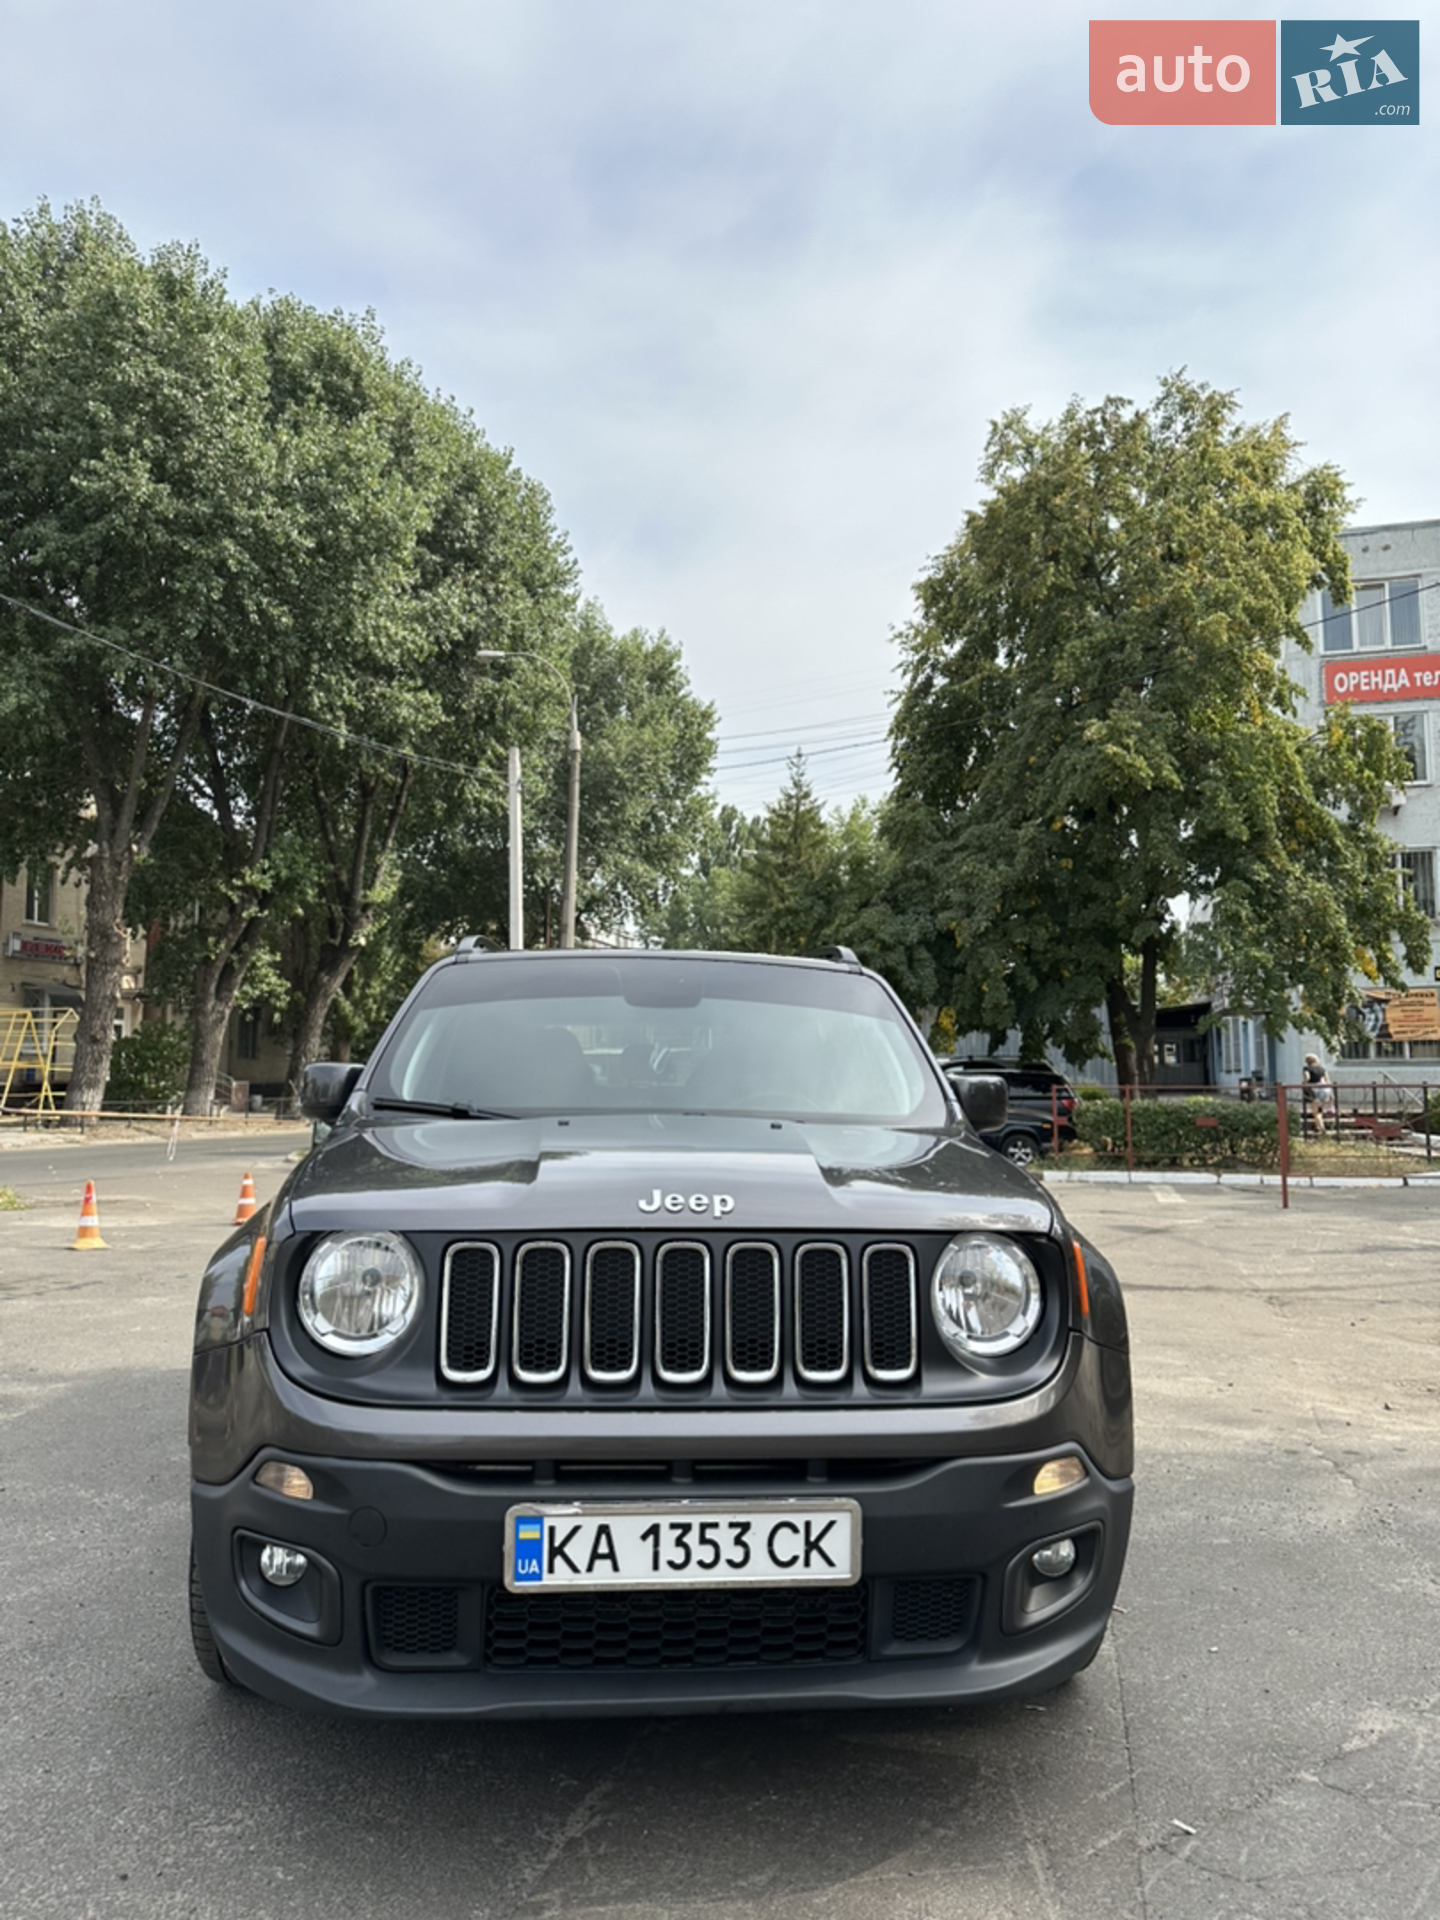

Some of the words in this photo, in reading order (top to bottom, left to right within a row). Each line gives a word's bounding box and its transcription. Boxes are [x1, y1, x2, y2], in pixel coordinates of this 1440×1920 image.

[1333, 668, 1411, 693] ОРЕНДА
[637, 1188, 735, 1220] Jeep
[547, 1524, 620, 1574] KA
[640, 1521, 752, 1571] 1353
[767, 1519, 837, 1568] CK
[517, 1558, 540, 1574] UA
